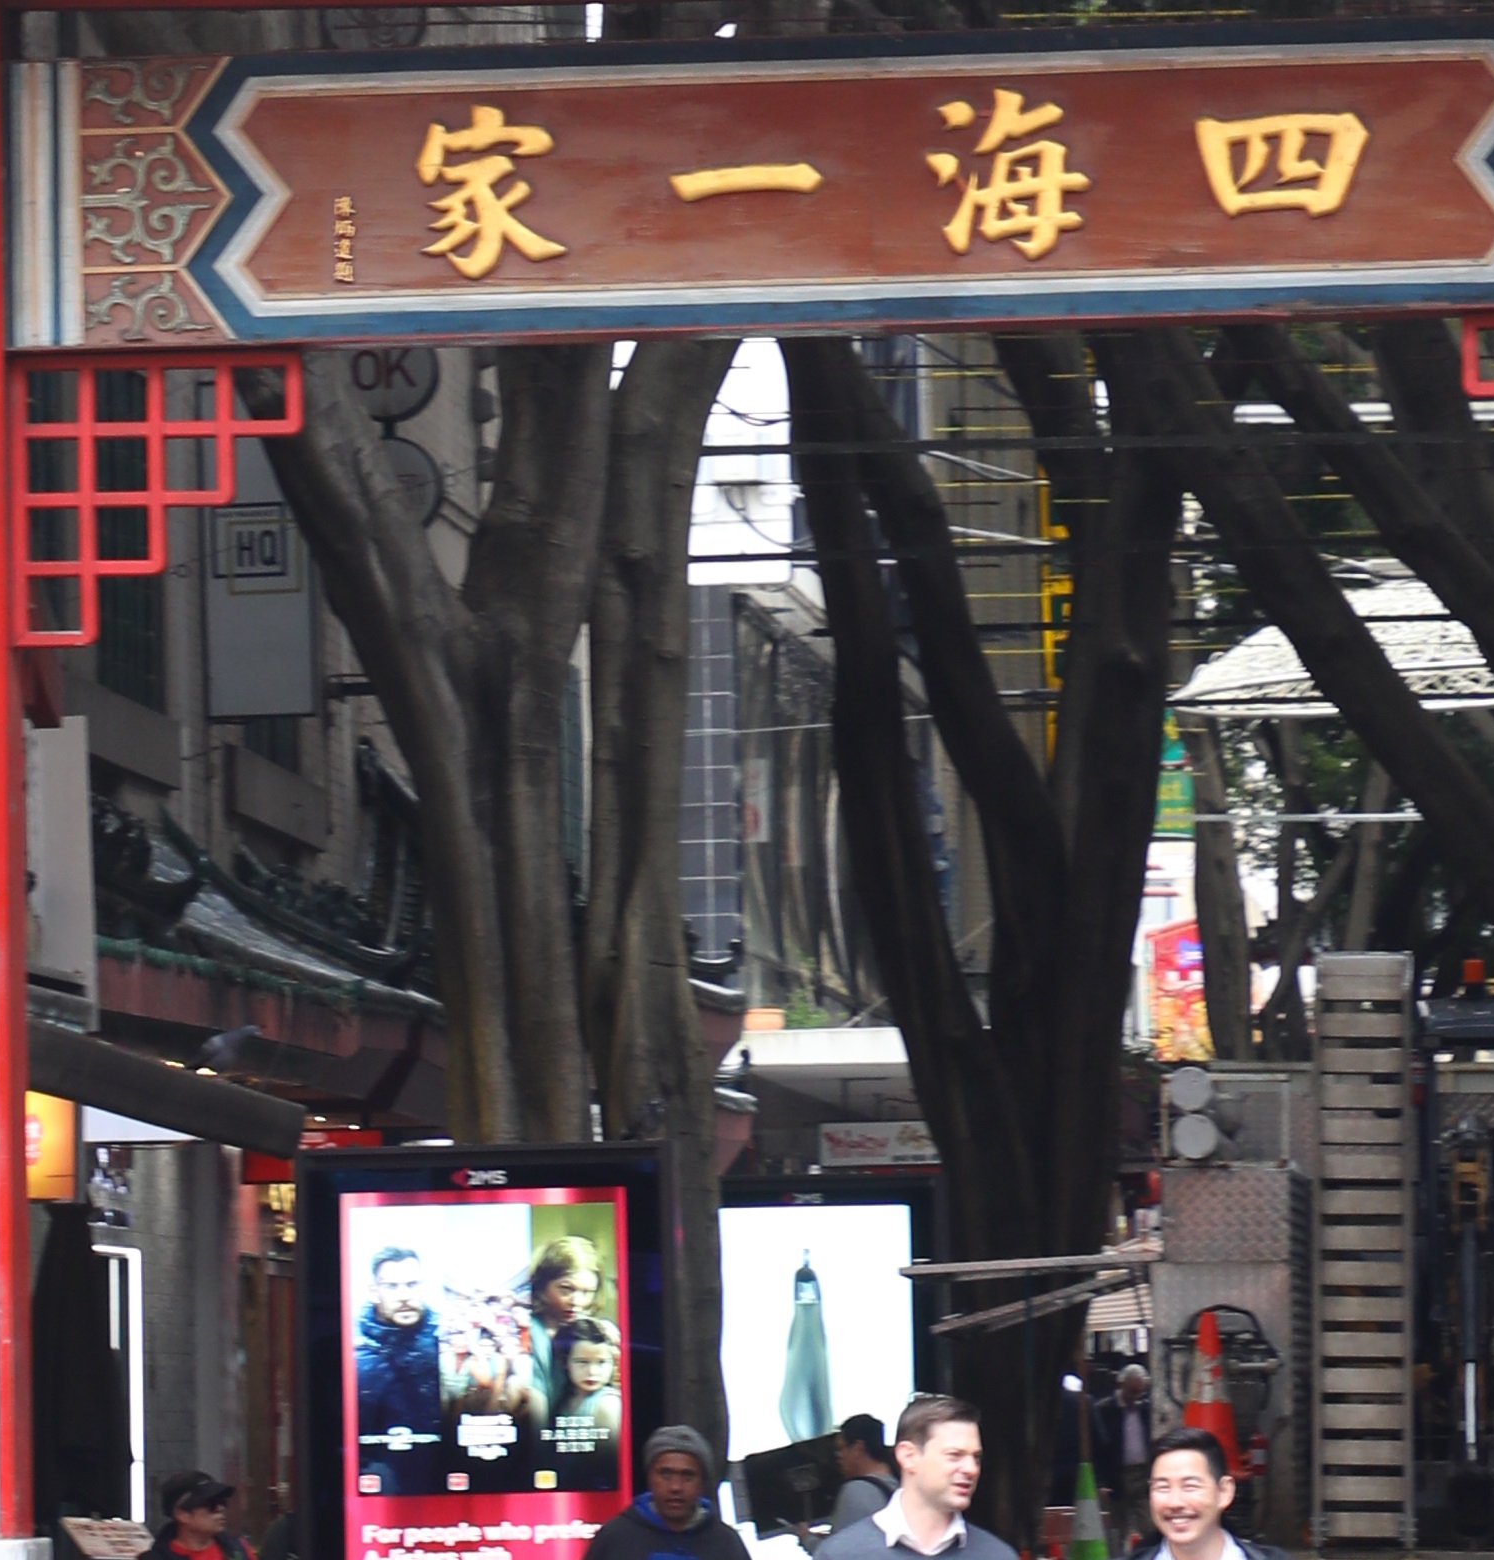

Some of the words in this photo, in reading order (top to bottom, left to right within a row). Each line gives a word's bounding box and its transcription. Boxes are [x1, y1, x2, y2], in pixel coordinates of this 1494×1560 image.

[415, 87, 1370, 280] 四海一家
[352, 348, 418, 391] OK
[235, 529, 277, 567] HQ
[363, 1525, 402, 1543] For
[405, 1523, 481, 1547] people
[484, 1522, 531, 1540] who
